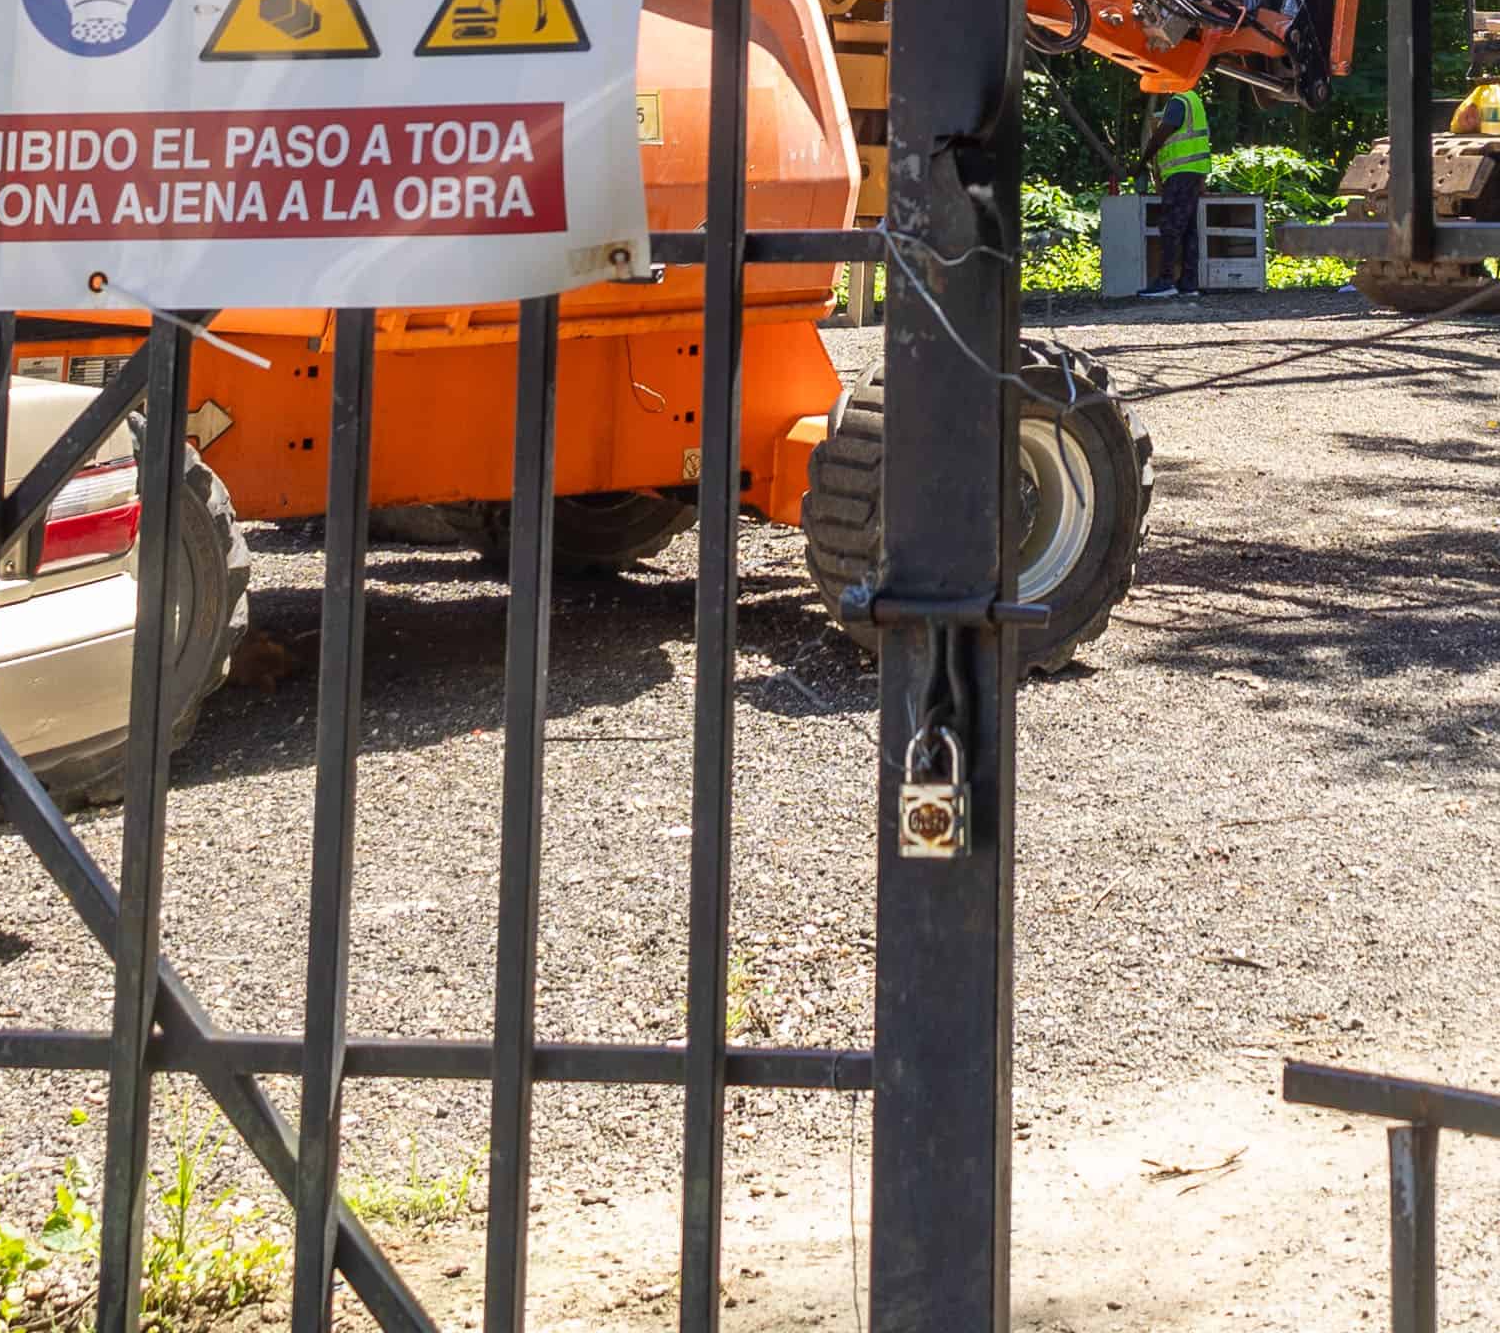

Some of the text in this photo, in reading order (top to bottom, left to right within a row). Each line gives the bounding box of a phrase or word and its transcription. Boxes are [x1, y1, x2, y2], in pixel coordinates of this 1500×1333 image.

[152, 128, 210, 170] EL
[226, 125, 349, 168] PASO
[360, 124, 391, 165] A
[405, 121, 534, 164] TODA
[112, 181, 267, 224] AJENA
[278, 180, 309, 221] A
[323, 179, 380, 220] LA
[394, 175, 533, 221] OBRA
